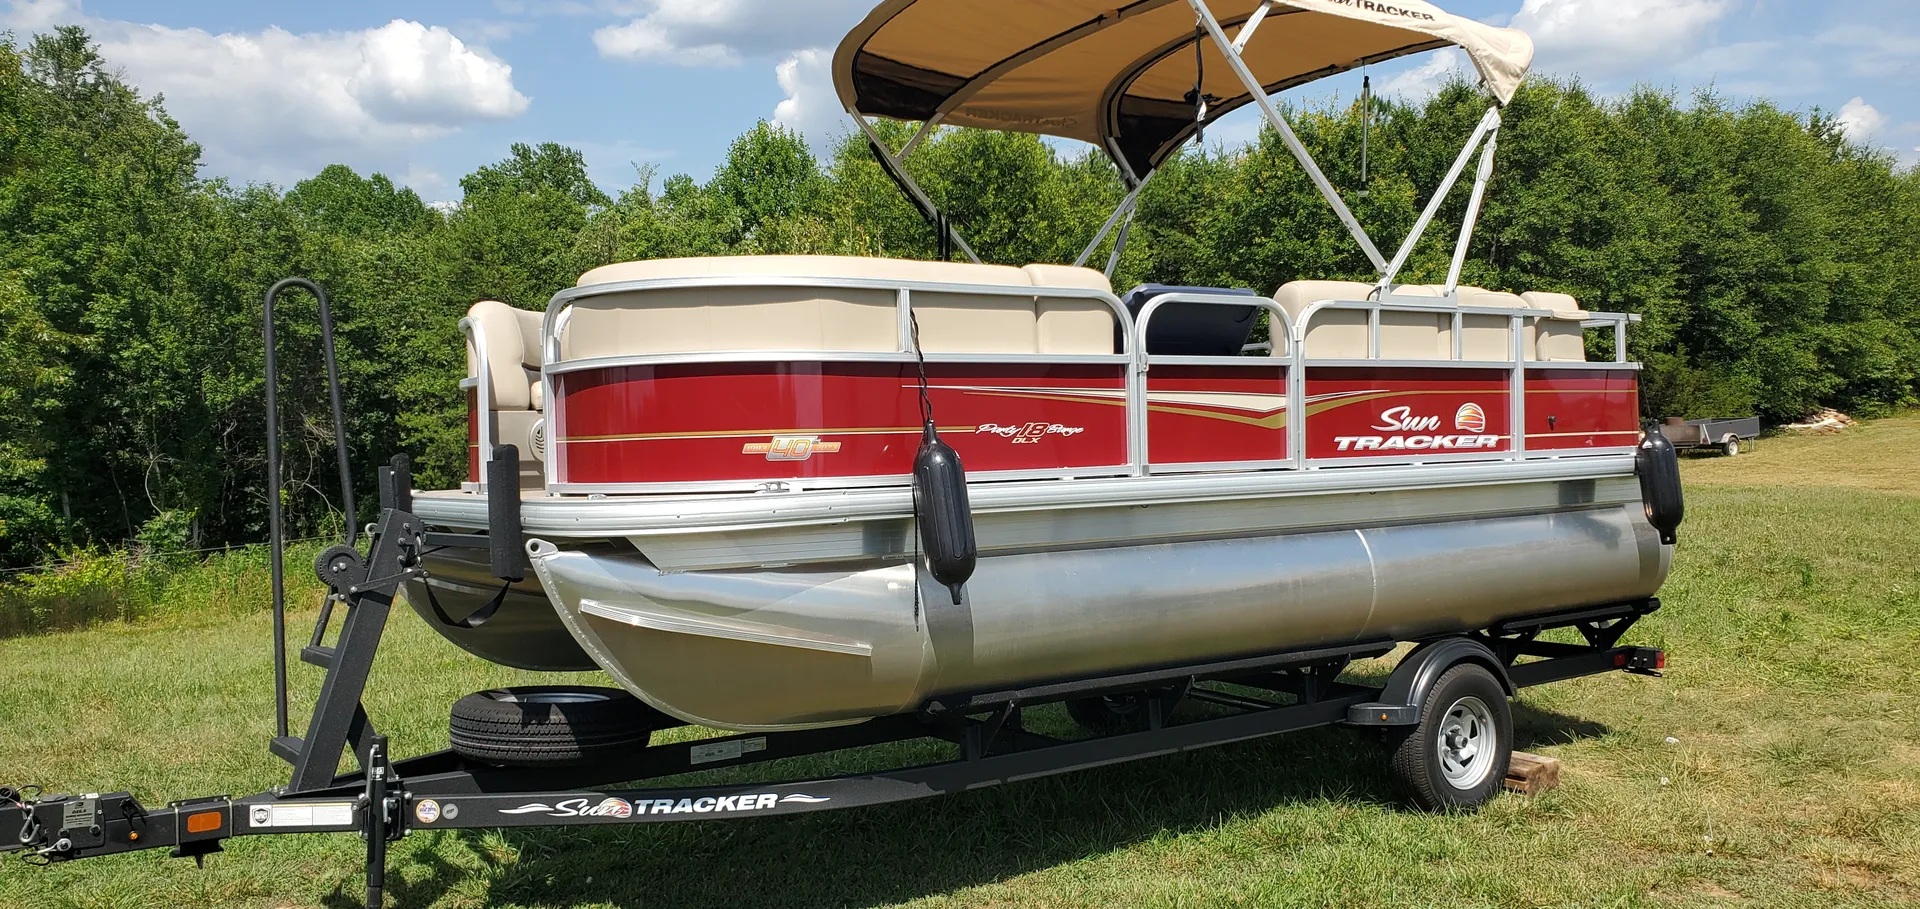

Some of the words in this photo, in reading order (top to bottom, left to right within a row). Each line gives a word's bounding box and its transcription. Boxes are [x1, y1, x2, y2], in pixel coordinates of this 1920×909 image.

[1355, 0, 1435, 21] TRACKER
[1370, 406, 1441, 431] Sun
[976, 423, 1022, 437] Party
[1016, 422, 1050, 438] 18
[1047, 424, 1084, 436] Barge
[773, 439, 811, 457] 40
[1334, 434, 1499, 451] TRACKER
[547, 798, 627, 818] Sun
[635, 793, 779, 815] TRACKER
